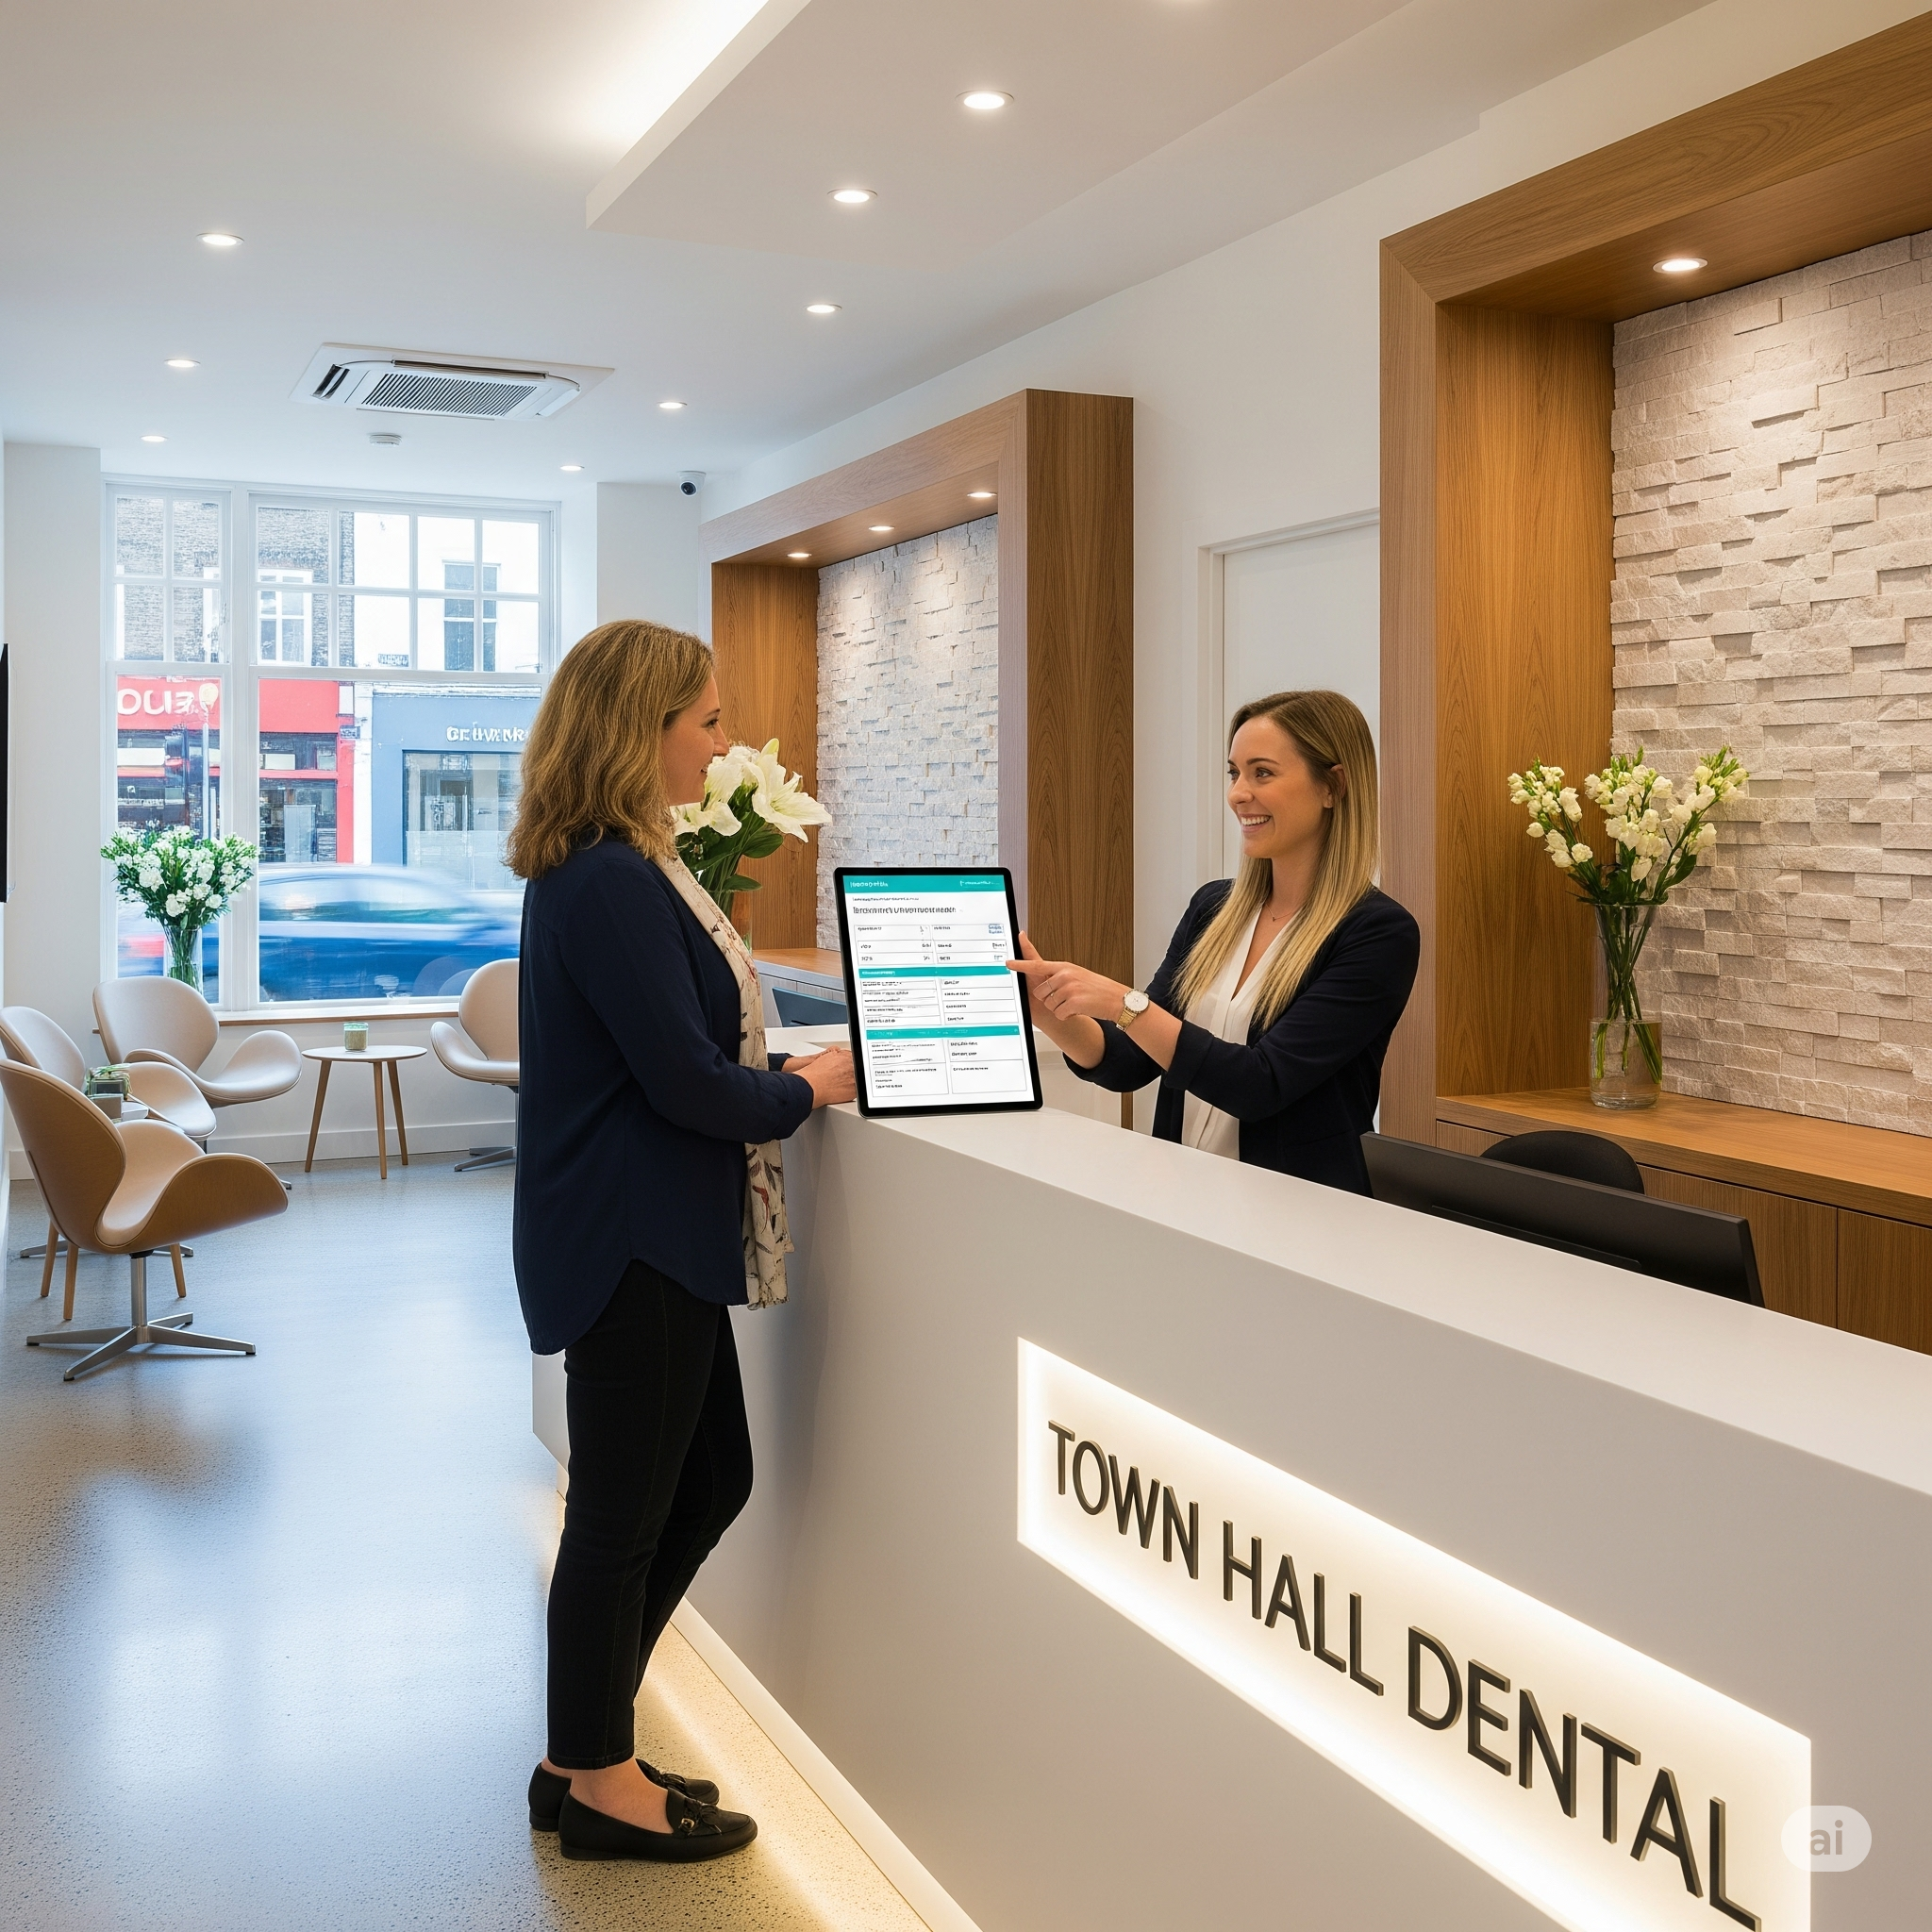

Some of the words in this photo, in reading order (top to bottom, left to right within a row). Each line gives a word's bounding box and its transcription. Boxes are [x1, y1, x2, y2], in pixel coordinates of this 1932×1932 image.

[1048, 1421, 1199, 1580] TOWN
[1223, 1520, 1385, 1697] HALL
[1407, 1625, 1762, 1932] DENTAL
